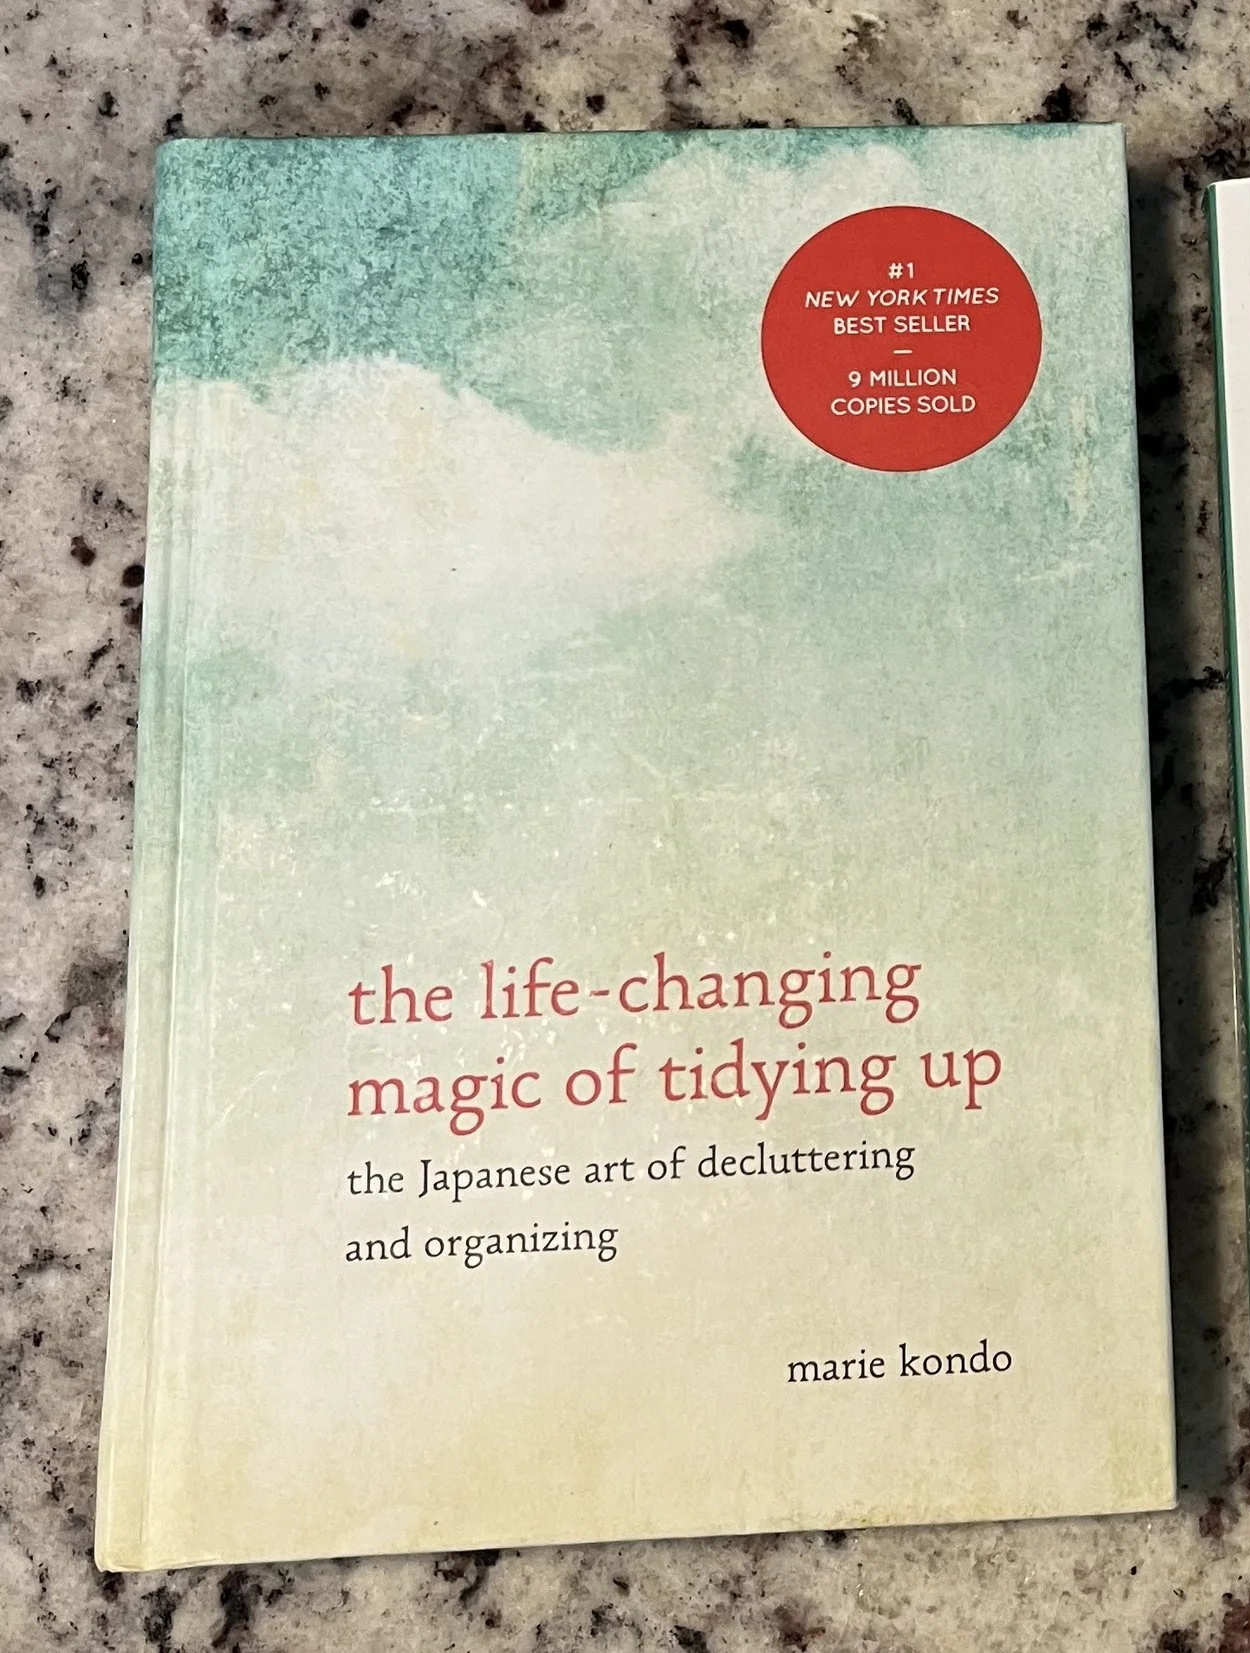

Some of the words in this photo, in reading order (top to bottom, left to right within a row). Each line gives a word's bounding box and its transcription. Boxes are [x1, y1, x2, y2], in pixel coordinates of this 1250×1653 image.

[889, 263, 913, 279] #1
[806, 291, 859, 307] NEW
[868, 289, 927, 306] YORK
[933, 288, 999, 304] TIMES
[834, 317, 886, 334] BEST
[894, 315, 970, 332] SELLER
[849, 371, 861, 387] 9
[870, 369, 956, 386] MILLION
[831, 397, 911, 416] COPIES
[918, 396, 975, 413] SOLD
[348, 964, 452, 1025] the
[481, 951, 921, 1029] life-changing
[348, 1057, 541, 1136] magic
[566, 1043, 637, 1106] of
[659, 1038, 897, 1120] tidying
[920, 1049, 1001, 1110] up
[348, 1161, 403, 1194] the
[419, 1160, 570, 1203] Japanese
[585, 1158, 634, 1183] art
[648, 1146, 686, 1180] of
[698, 1141, 915, 1180] decluttering
[346, 1226, 411, 1261] and
[425, 1222, 618, 1268] organizing
[788, 1350, 884, 1382] marie
[899, 1339, 1011, 1376] kondo
